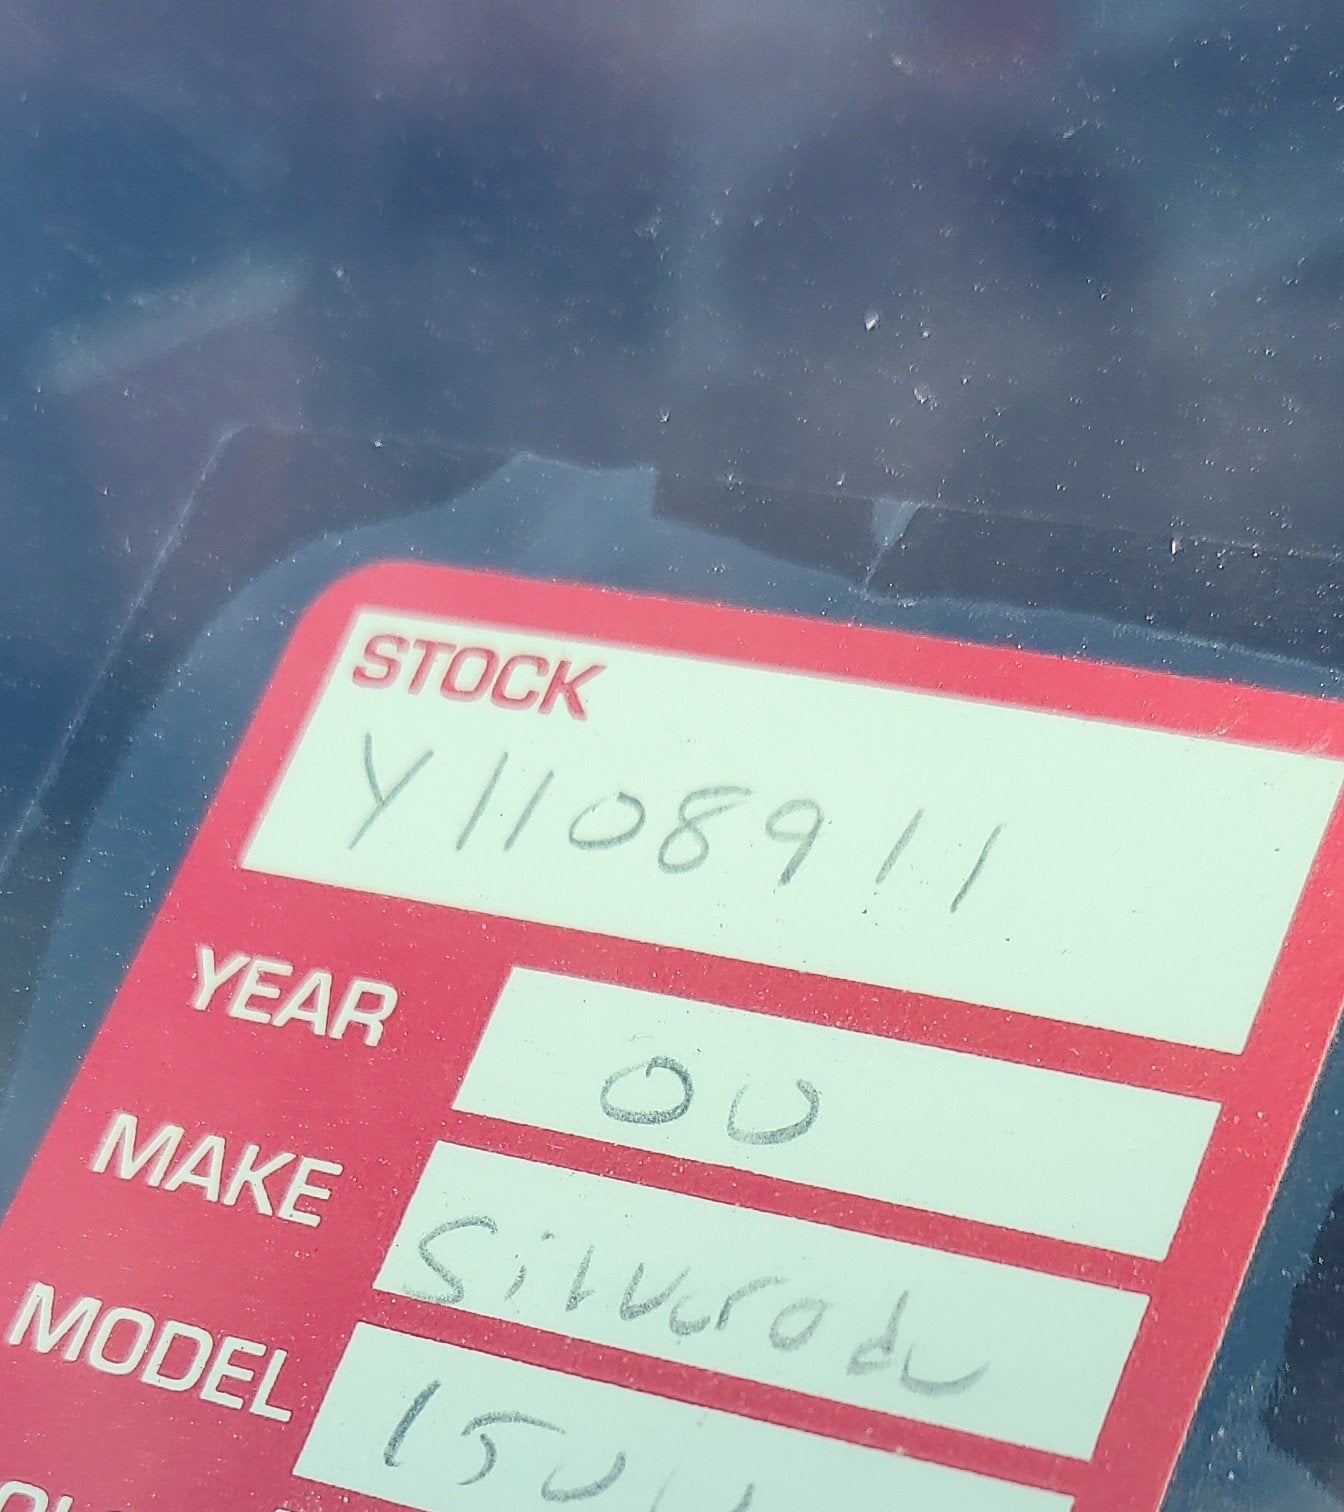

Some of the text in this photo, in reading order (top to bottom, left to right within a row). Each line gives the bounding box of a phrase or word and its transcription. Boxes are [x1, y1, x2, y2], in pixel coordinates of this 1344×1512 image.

[350, 634, 606, 721] STOCK
[348, 733, 1003, 913] Y1108911
[193, 946, 399, 1046] YEAR
[92, 1112, 344, 1226] MAKE
[8, 1281, 294, 1422] MODEL
